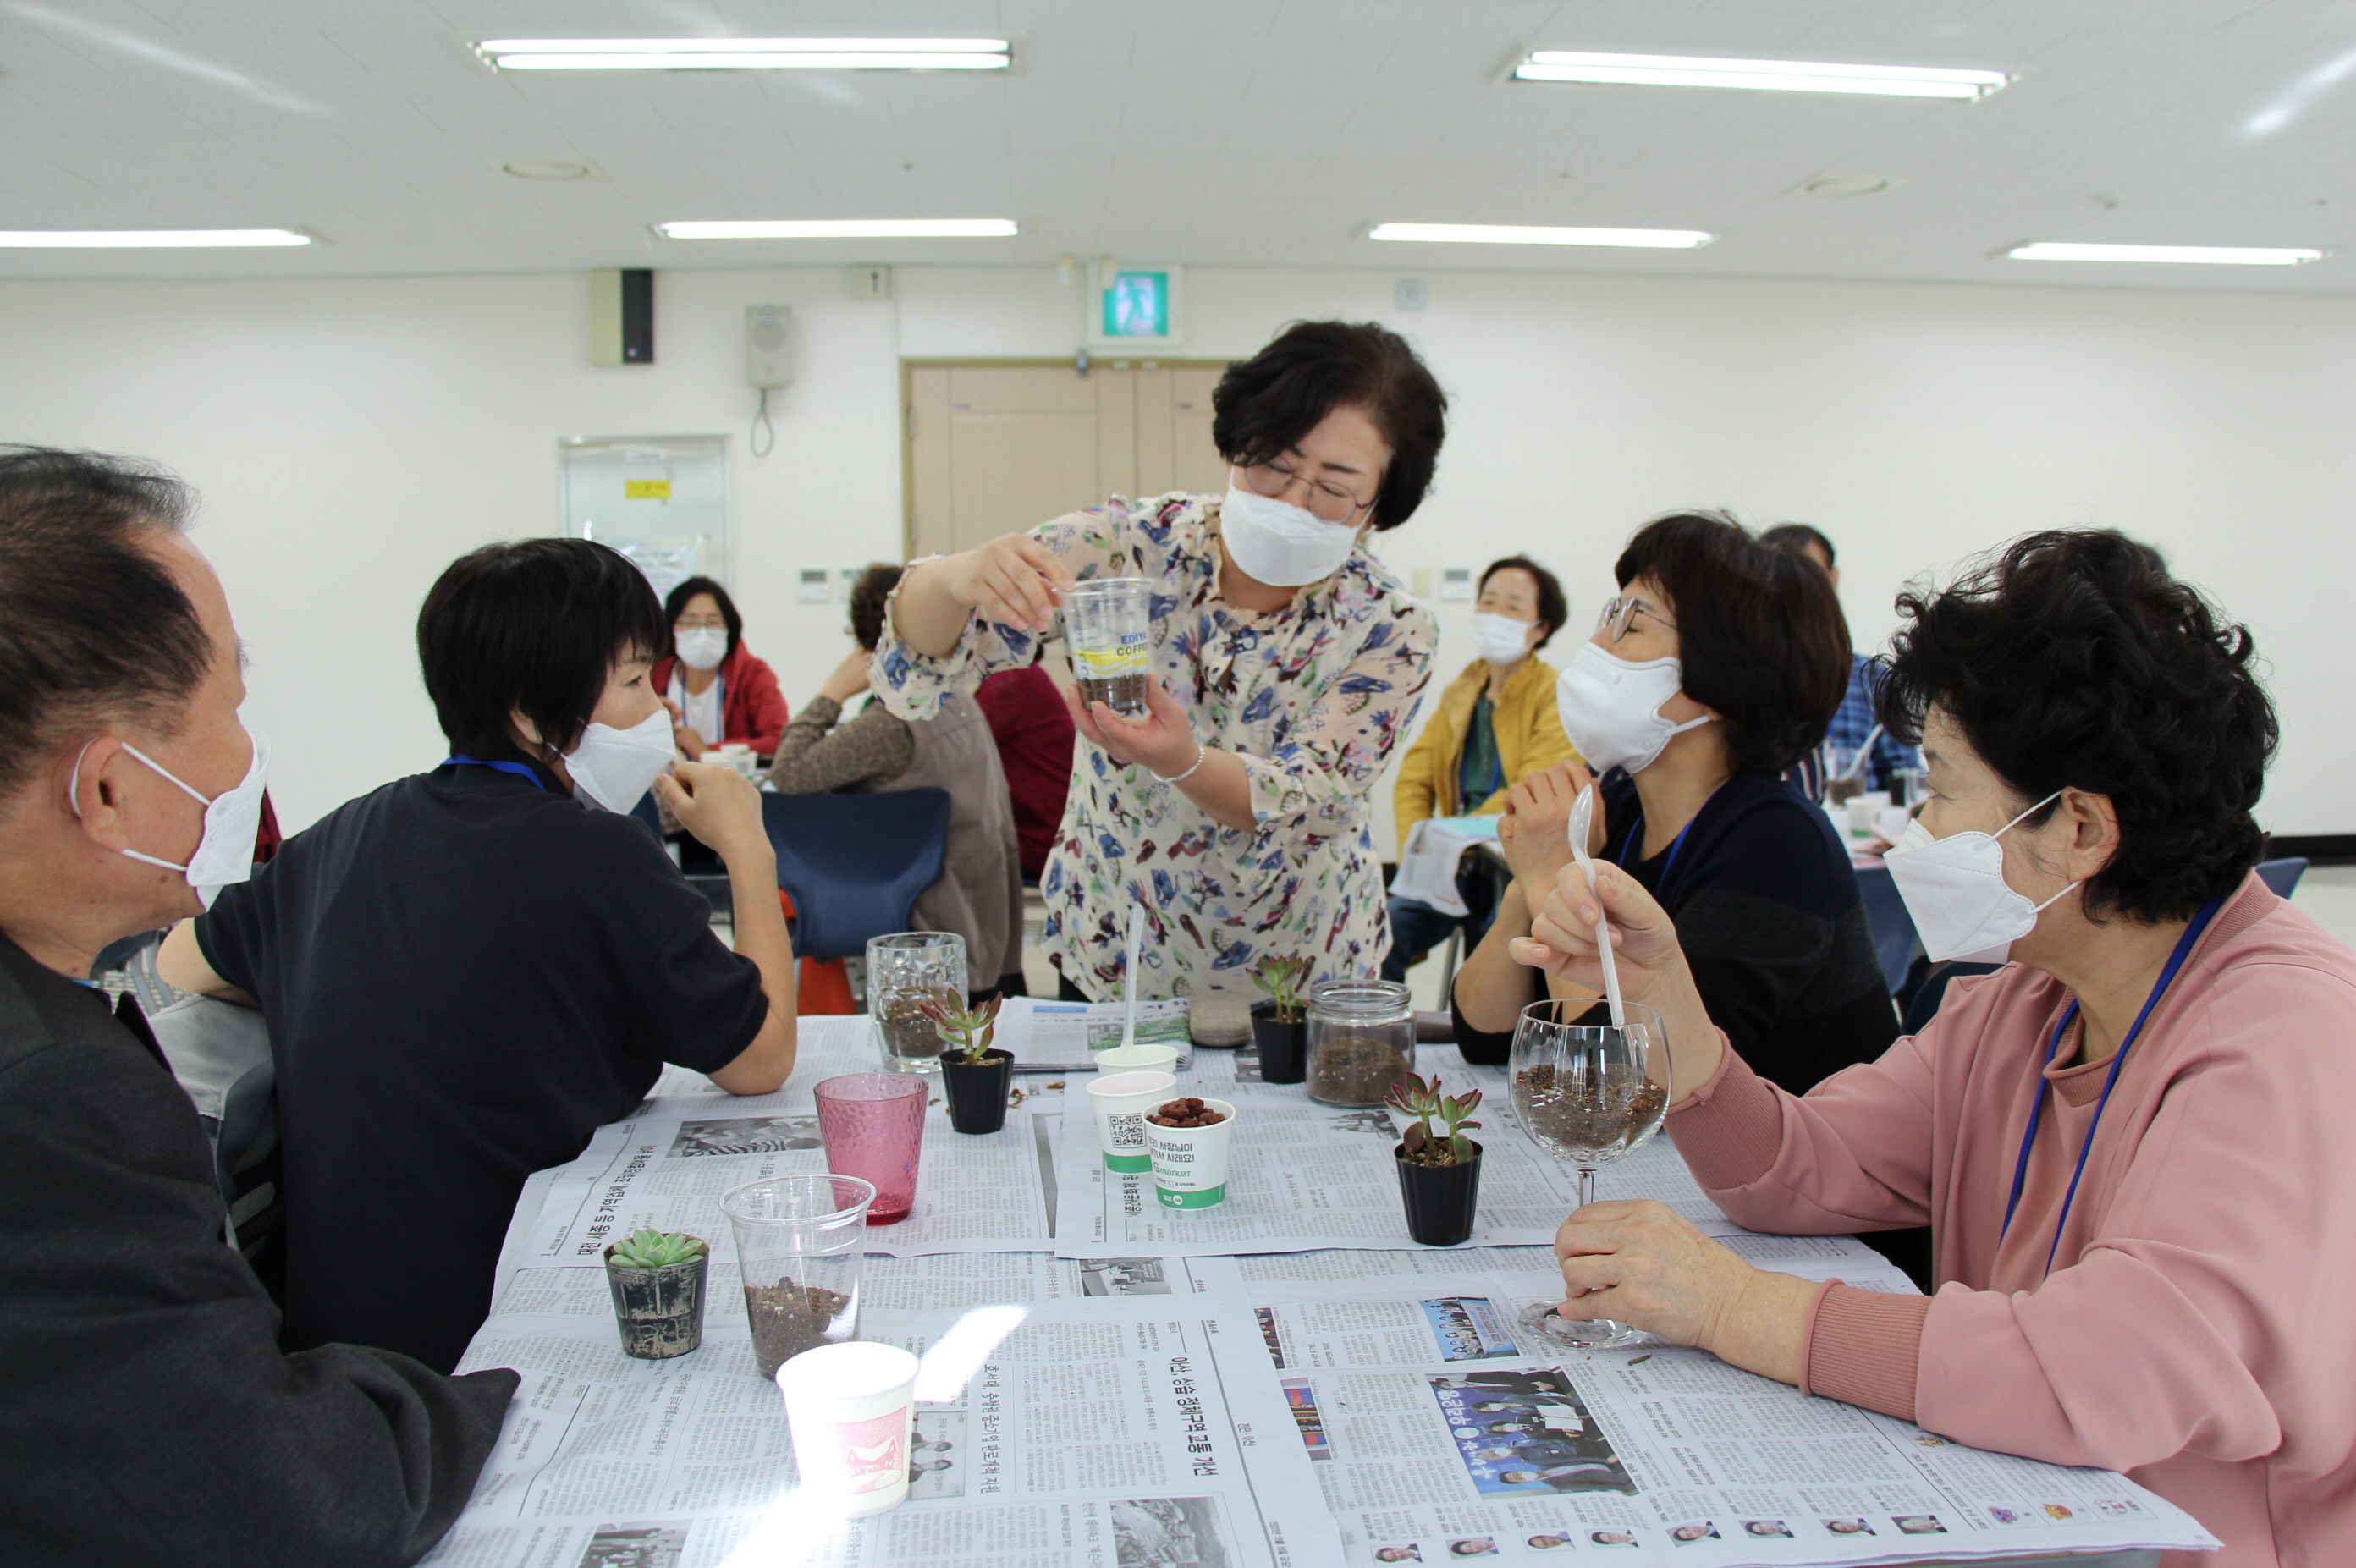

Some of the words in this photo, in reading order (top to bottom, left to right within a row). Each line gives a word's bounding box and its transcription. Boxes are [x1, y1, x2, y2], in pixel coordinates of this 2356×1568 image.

[1160, 1142, 1192, 1152] 사장님이
[1167, 1153, 1195, 1162] 사래요!
[1153, 1161, 1191, 1177] Gmarket
[1168, 1356, 1192, 1376] 아산,
[981, 1364, 1000, 1390] 호서대,
[1173, 1378, 1197, 1395] 상습
[982, 1392, 1000, 1414] 충청권
[1177, 1397, 1207, 1433] 정체구역
[981, 1415, 1000, 1442] 중소기업
[649, 1428, 670, 1457] 국무총리상
[1188, 1434, 1212, 1454] 교통
[980, 1444, 1000, 1474] 판로개척
[1192, 1457, 1219, 1477] 개선
[980, 1477, 1001, 1494] 지원
